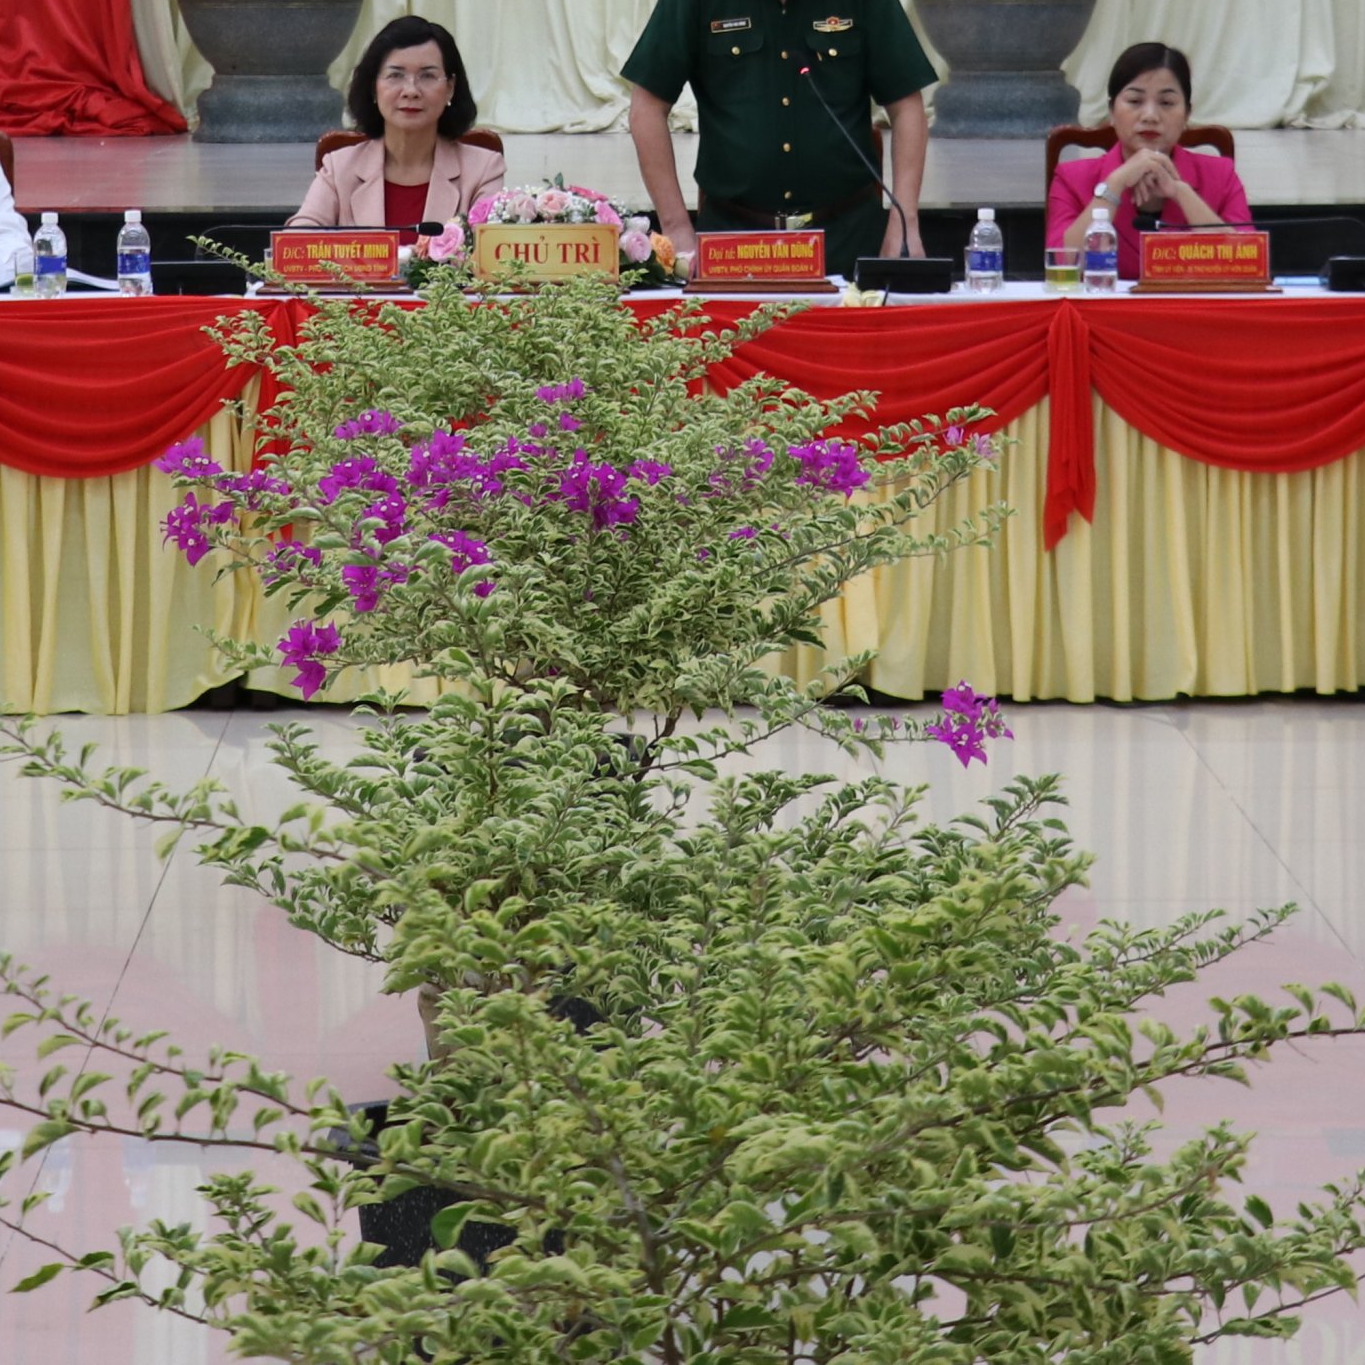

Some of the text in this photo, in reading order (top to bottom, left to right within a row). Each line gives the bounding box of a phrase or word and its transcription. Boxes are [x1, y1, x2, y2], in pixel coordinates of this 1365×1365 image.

[306, 239, 332, 259] TRẦN
[333, 239, 361, 259] TUYẾT
[363, 243, 389, 259] MINH
[494, 235, 601, 264] CHỦ TRÌ
[737, 239, 771, 260] NGUYỄN
[1178, 242, 1214, 260] QUÁCH
[1216, 244, 1233, 262] THỊ
